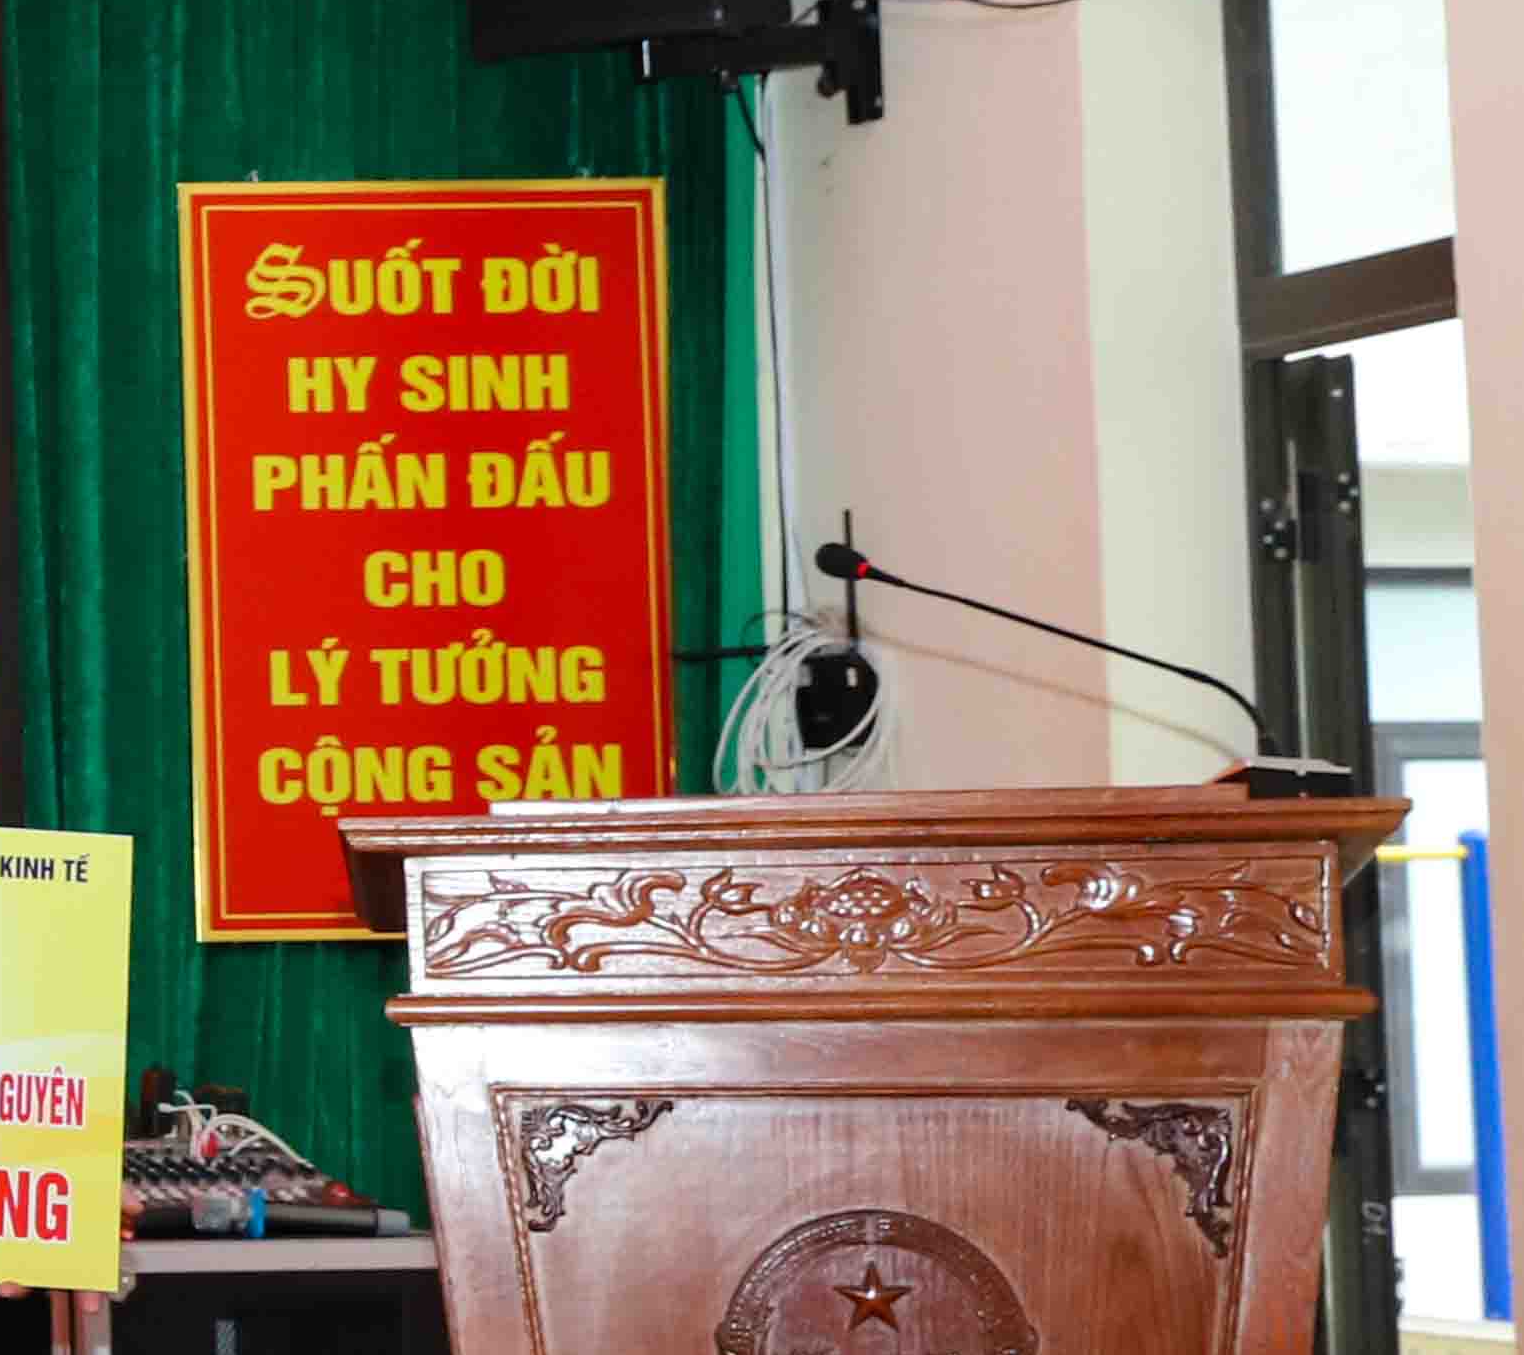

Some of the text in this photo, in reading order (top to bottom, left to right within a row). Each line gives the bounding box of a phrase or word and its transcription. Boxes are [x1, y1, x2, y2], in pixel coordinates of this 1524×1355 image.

[245, 239, 599, 319] SUỐT ĐỜI
[288, 355, 569, 412] HY SINH
[253, 431, 610, 510] PHẤN ĐẤU
[365, 550, 504, 607] CHO
[270, 629, 605, 705] LÝ TƯỞNG
[259, 725, 621, 816] CỘNG SẢN
[0, 855, 55, 880] KINH
[62, 852, 89, 883] TẾ
